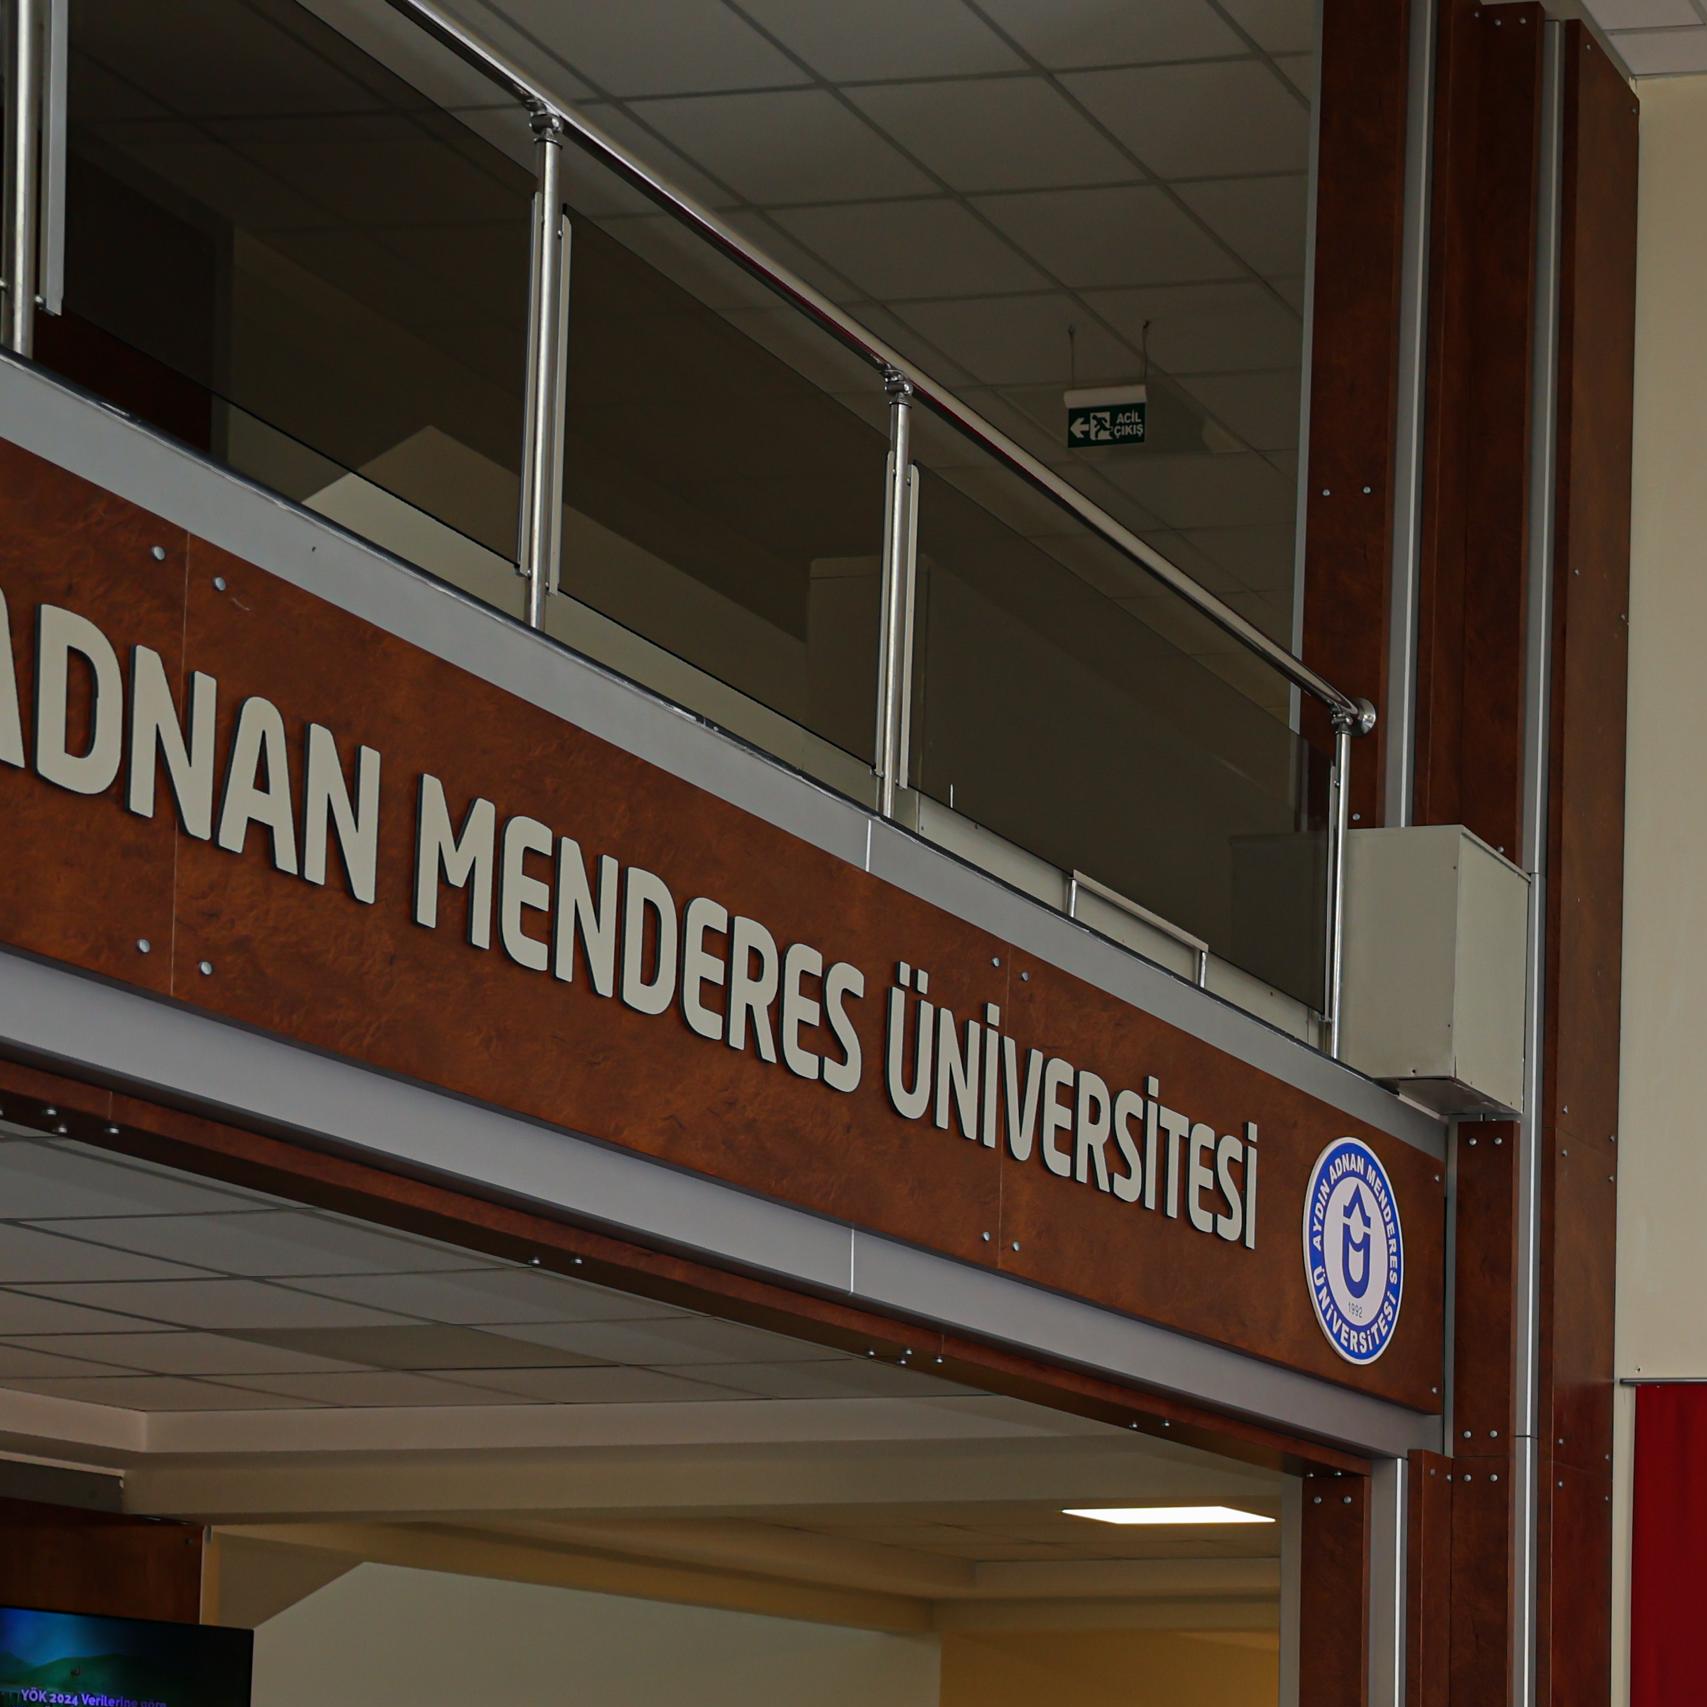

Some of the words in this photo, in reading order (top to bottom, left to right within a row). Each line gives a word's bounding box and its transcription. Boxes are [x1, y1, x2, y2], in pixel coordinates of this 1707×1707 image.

[1116, 408, 1142, 424] ACİL
[1113, 423, 1144, 439] ÇIKIŞ
[413, 772, 865, 1093] MENDERES
[887, 960, 1258, 1249] ÜNİVERSİTESİ
[1312, 1178, 1331, 1251] AYDIN
[1329, 1153, 1365, 1184] ADNAN
[1366, 1164, 1398, 1285] MENDERES
[1347, 1301, 1363, 1318] 1992
[21, 1687, 47, 1703] YÖK
[48, 1693, 79, 1707] 2024
